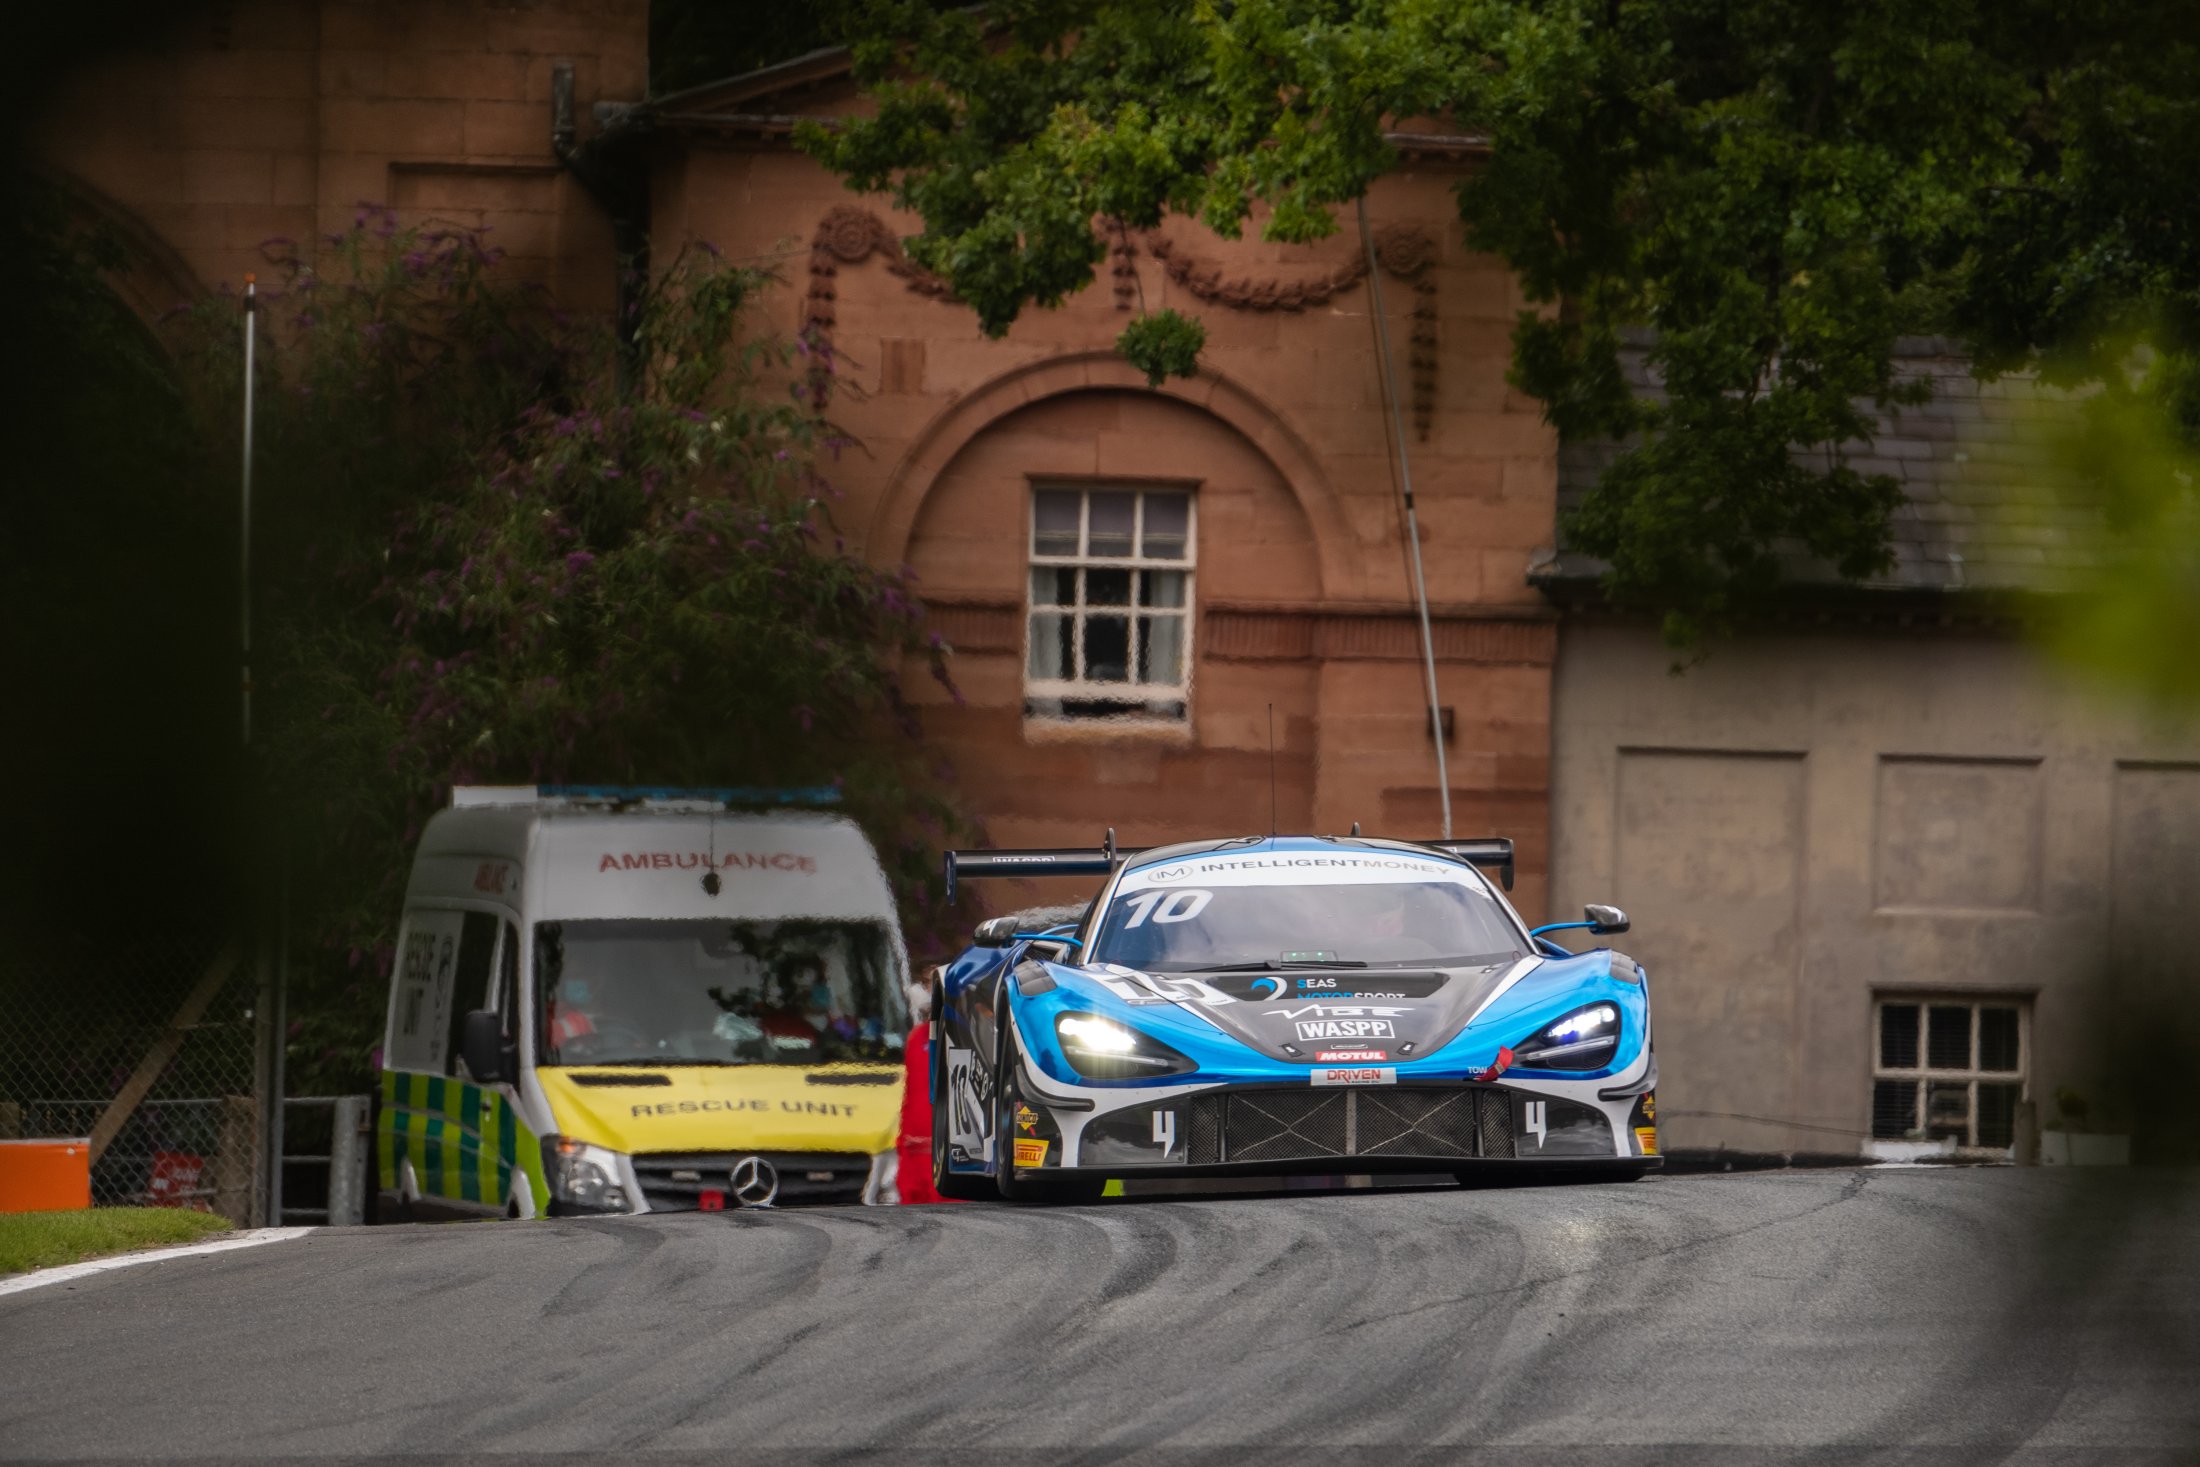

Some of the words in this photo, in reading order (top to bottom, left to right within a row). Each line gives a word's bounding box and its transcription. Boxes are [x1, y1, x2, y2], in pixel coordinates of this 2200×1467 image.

[599, 853, 817, 875] AMBULANCE
[1124, 889, 1213, 930] 10
[1297, 978, 1337, 988] SEAS
[1302, 1021, 1387, 1037] WASPP
[1320, 1051, 1383, 1060] MOTUL
[1327, 1069, 1381, 1082] DRIVEN
[1468, 1066, 1488, 1074] TOW
[631, 1100, 770, 1118] RESCUE
[782, 1101, 857, 1117] UNIT
